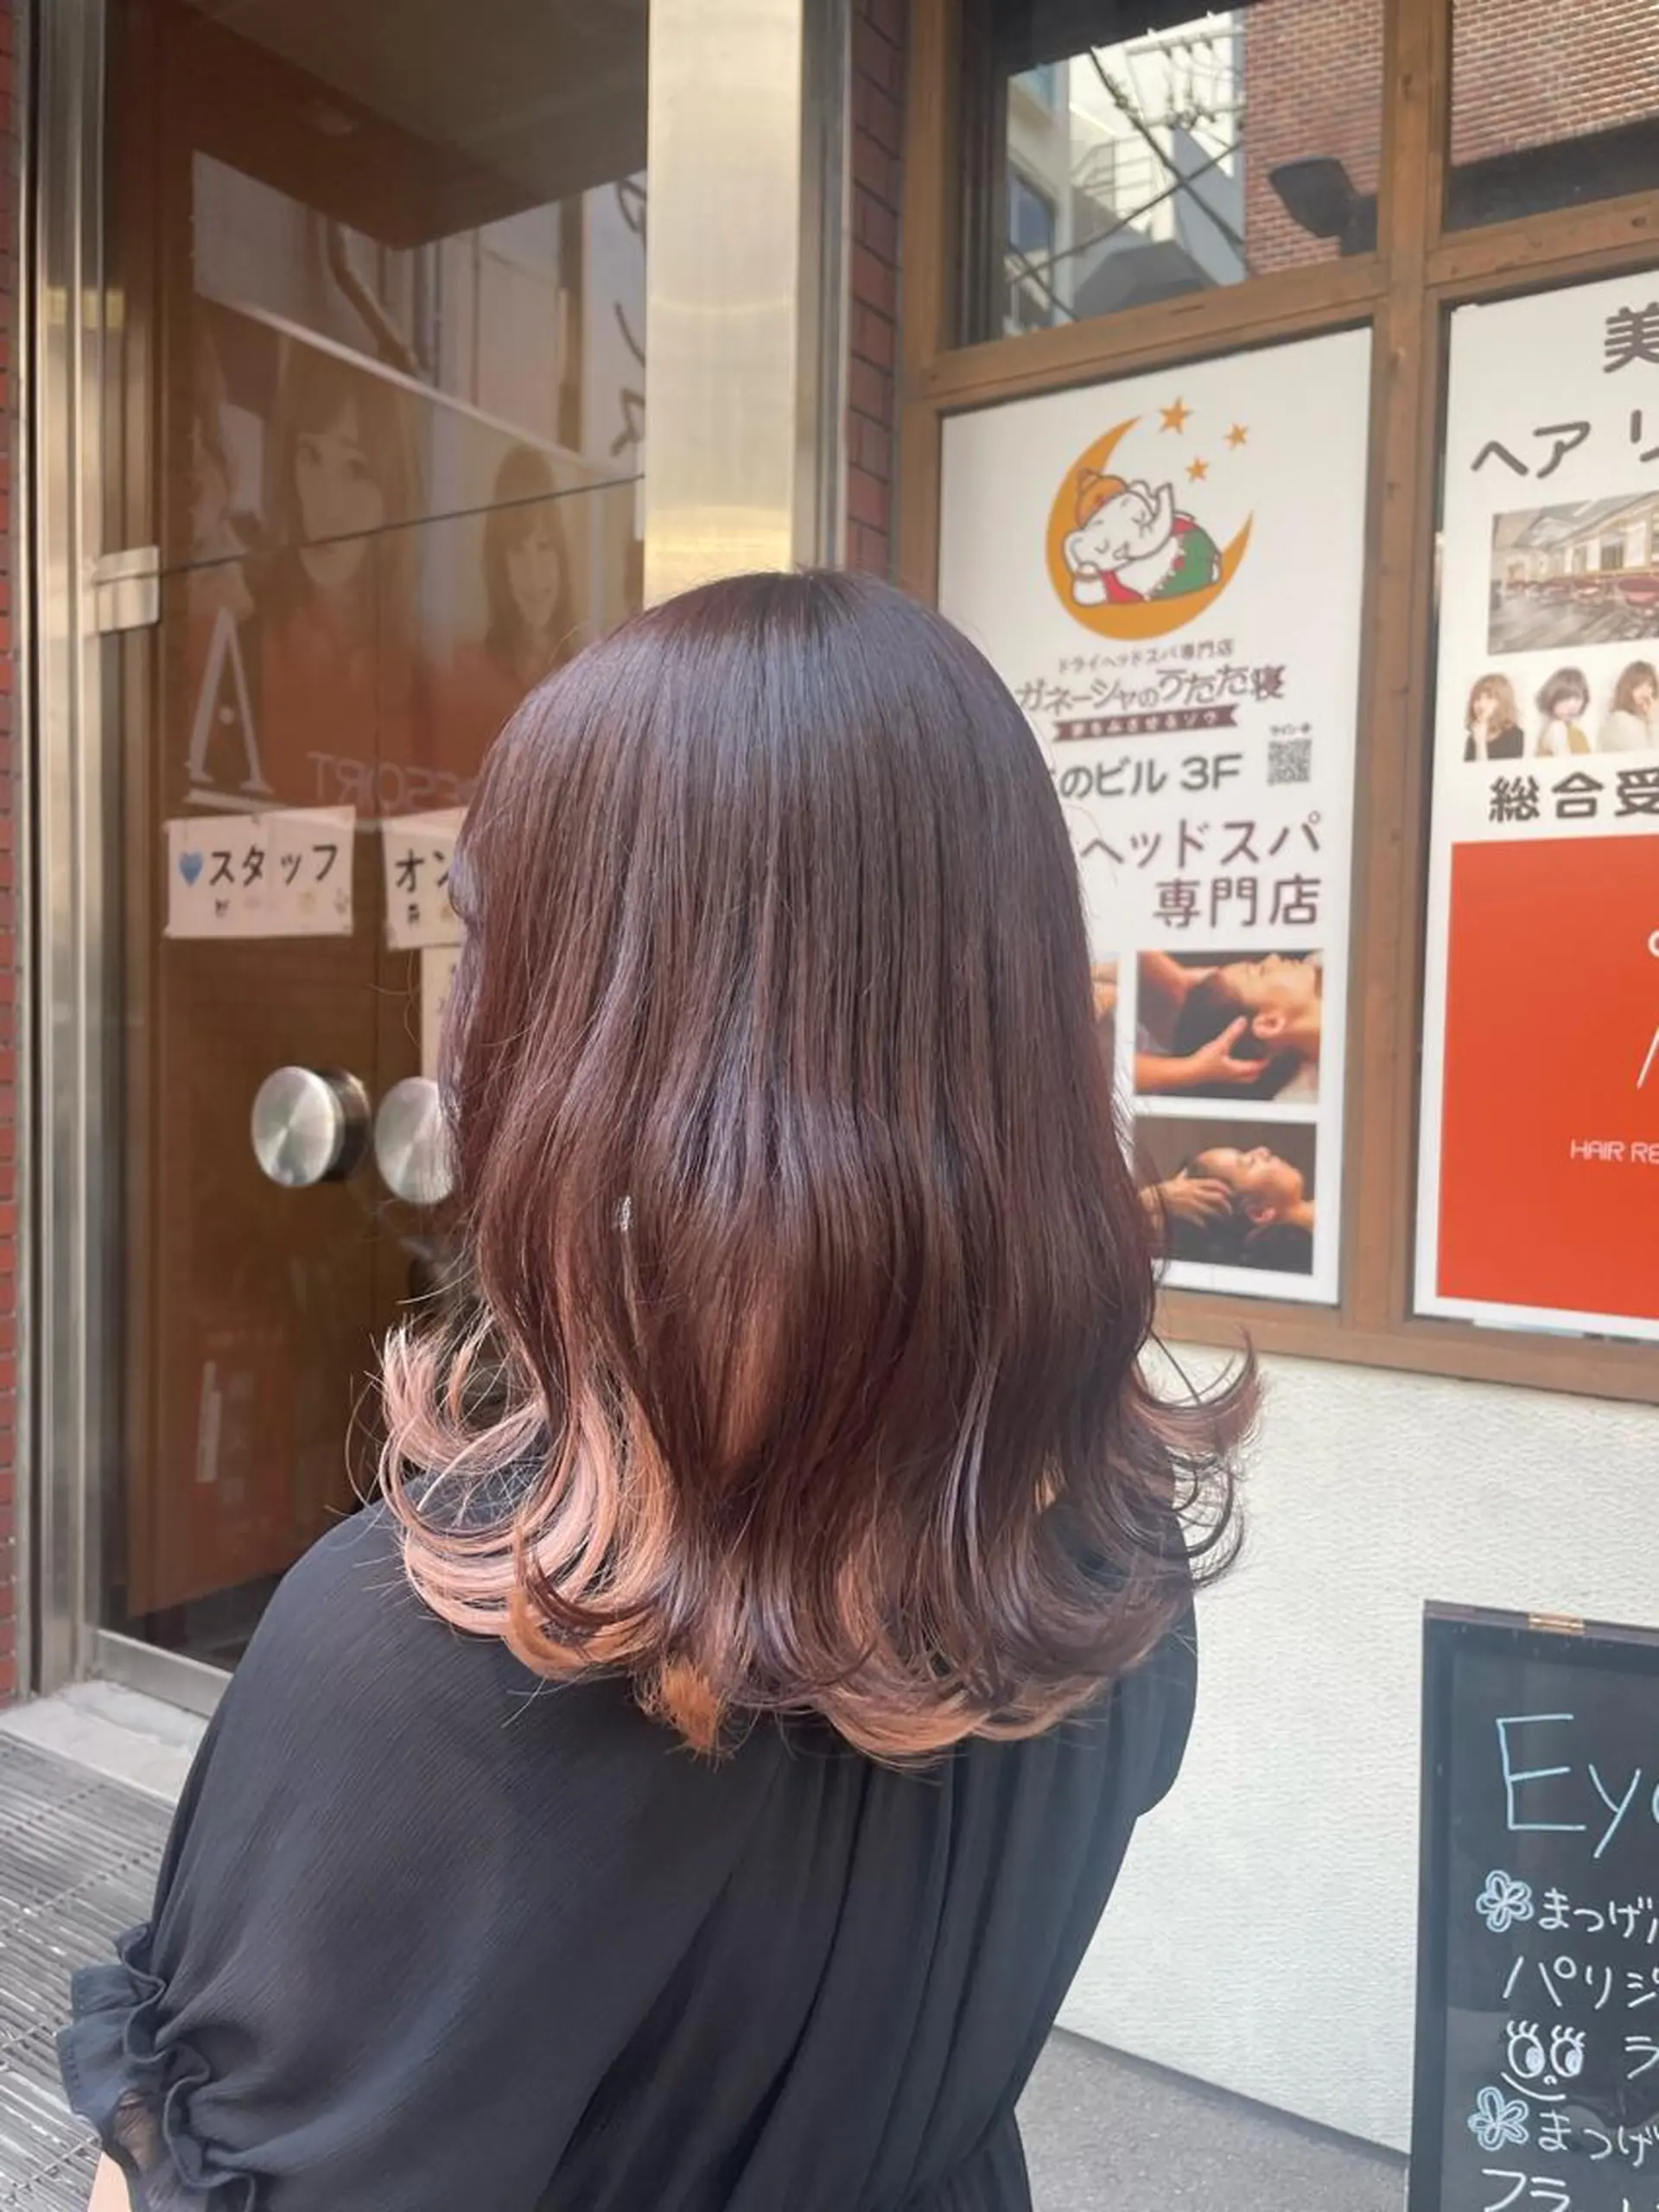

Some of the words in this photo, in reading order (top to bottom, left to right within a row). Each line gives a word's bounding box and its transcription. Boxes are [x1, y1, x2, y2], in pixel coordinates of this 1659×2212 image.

[1604, 302, 1659, 373] 美
[1049, 754, 1169, 800] のビル
[1180, 752, 1243, 791] 3F
[1489, 766, 1659, 823] 総合受
[208, 842, 339, 888] スタッフ
[1080, 810, 1322, 869] ヘッドスパ
[1153, 873, 1322, 929] 専門店
[1570, 1137, 1624, 1162] HAIR
[1496, 1713, 1659, 1859] Ey
[1537, 1886, 1658, 1945] まつげ
[1537, 2108, 1659, 2169] まつげ
